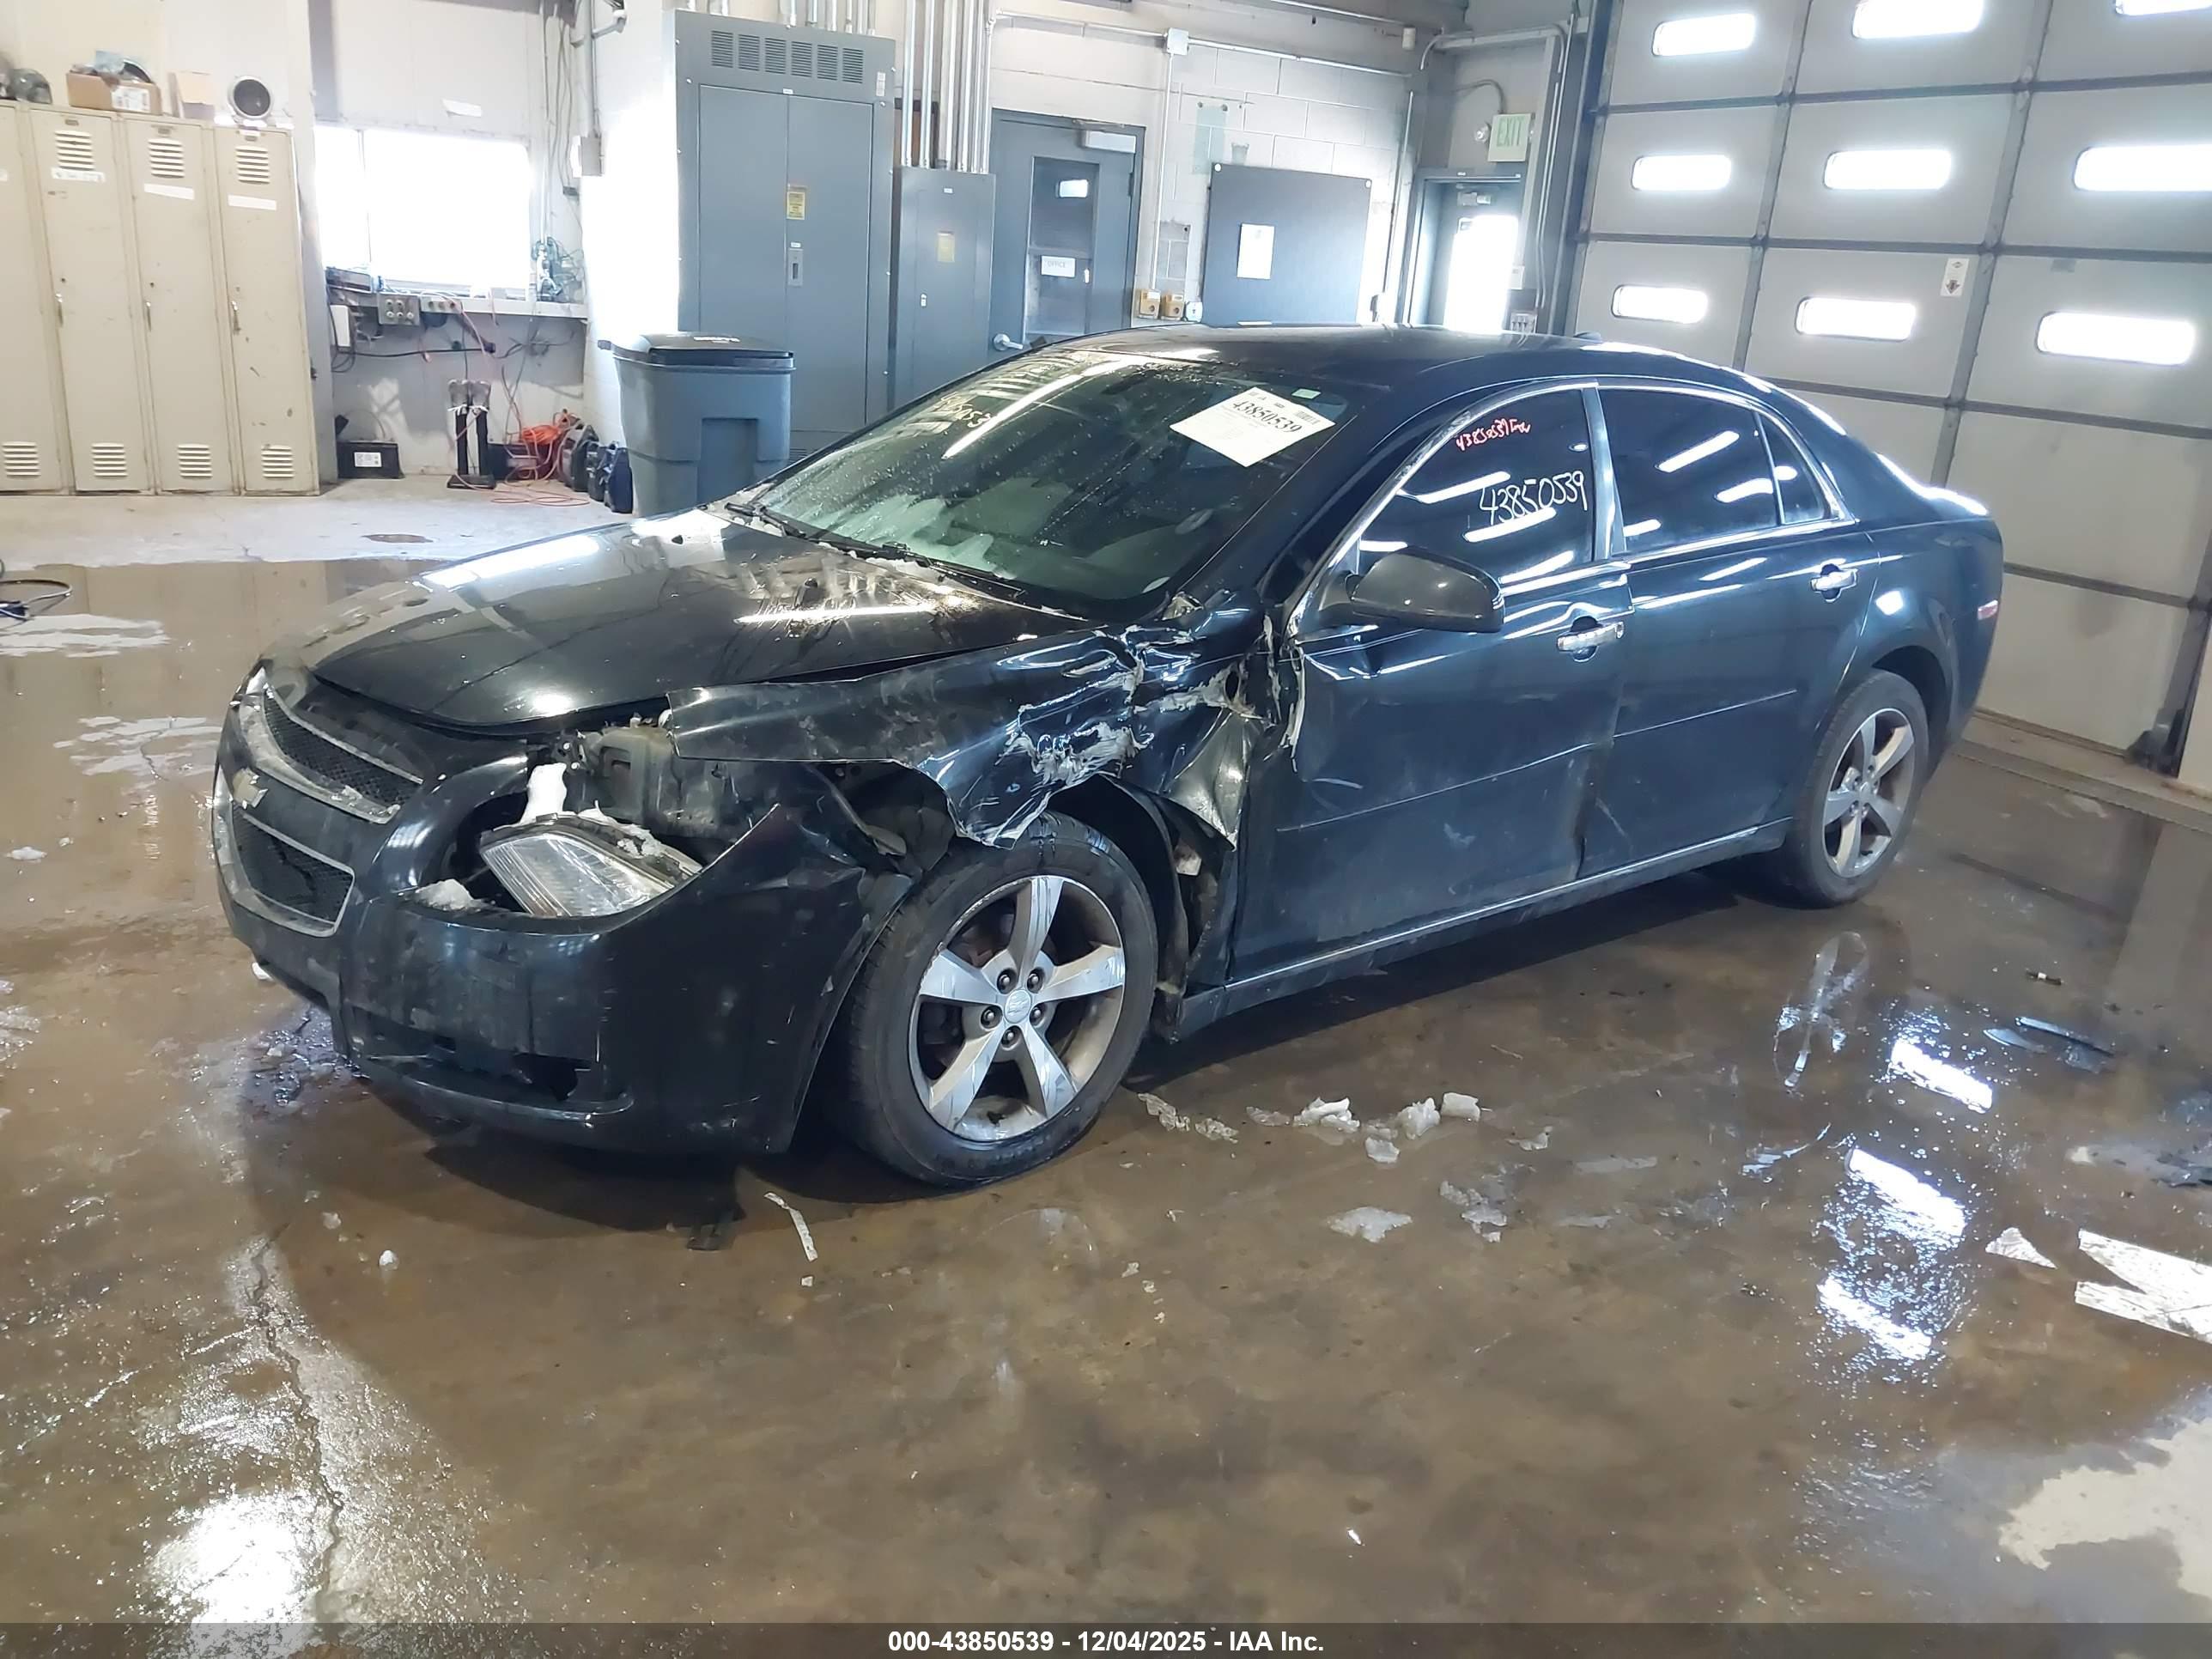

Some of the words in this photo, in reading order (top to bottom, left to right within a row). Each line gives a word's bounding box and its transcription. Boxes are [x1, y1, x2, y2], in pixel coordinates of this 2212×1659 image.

[1497, 117, 1524, 147] EXIT
[1232, 400, 1303, 433] 43850539
[1479, 470, 1588, 526] 43850539
